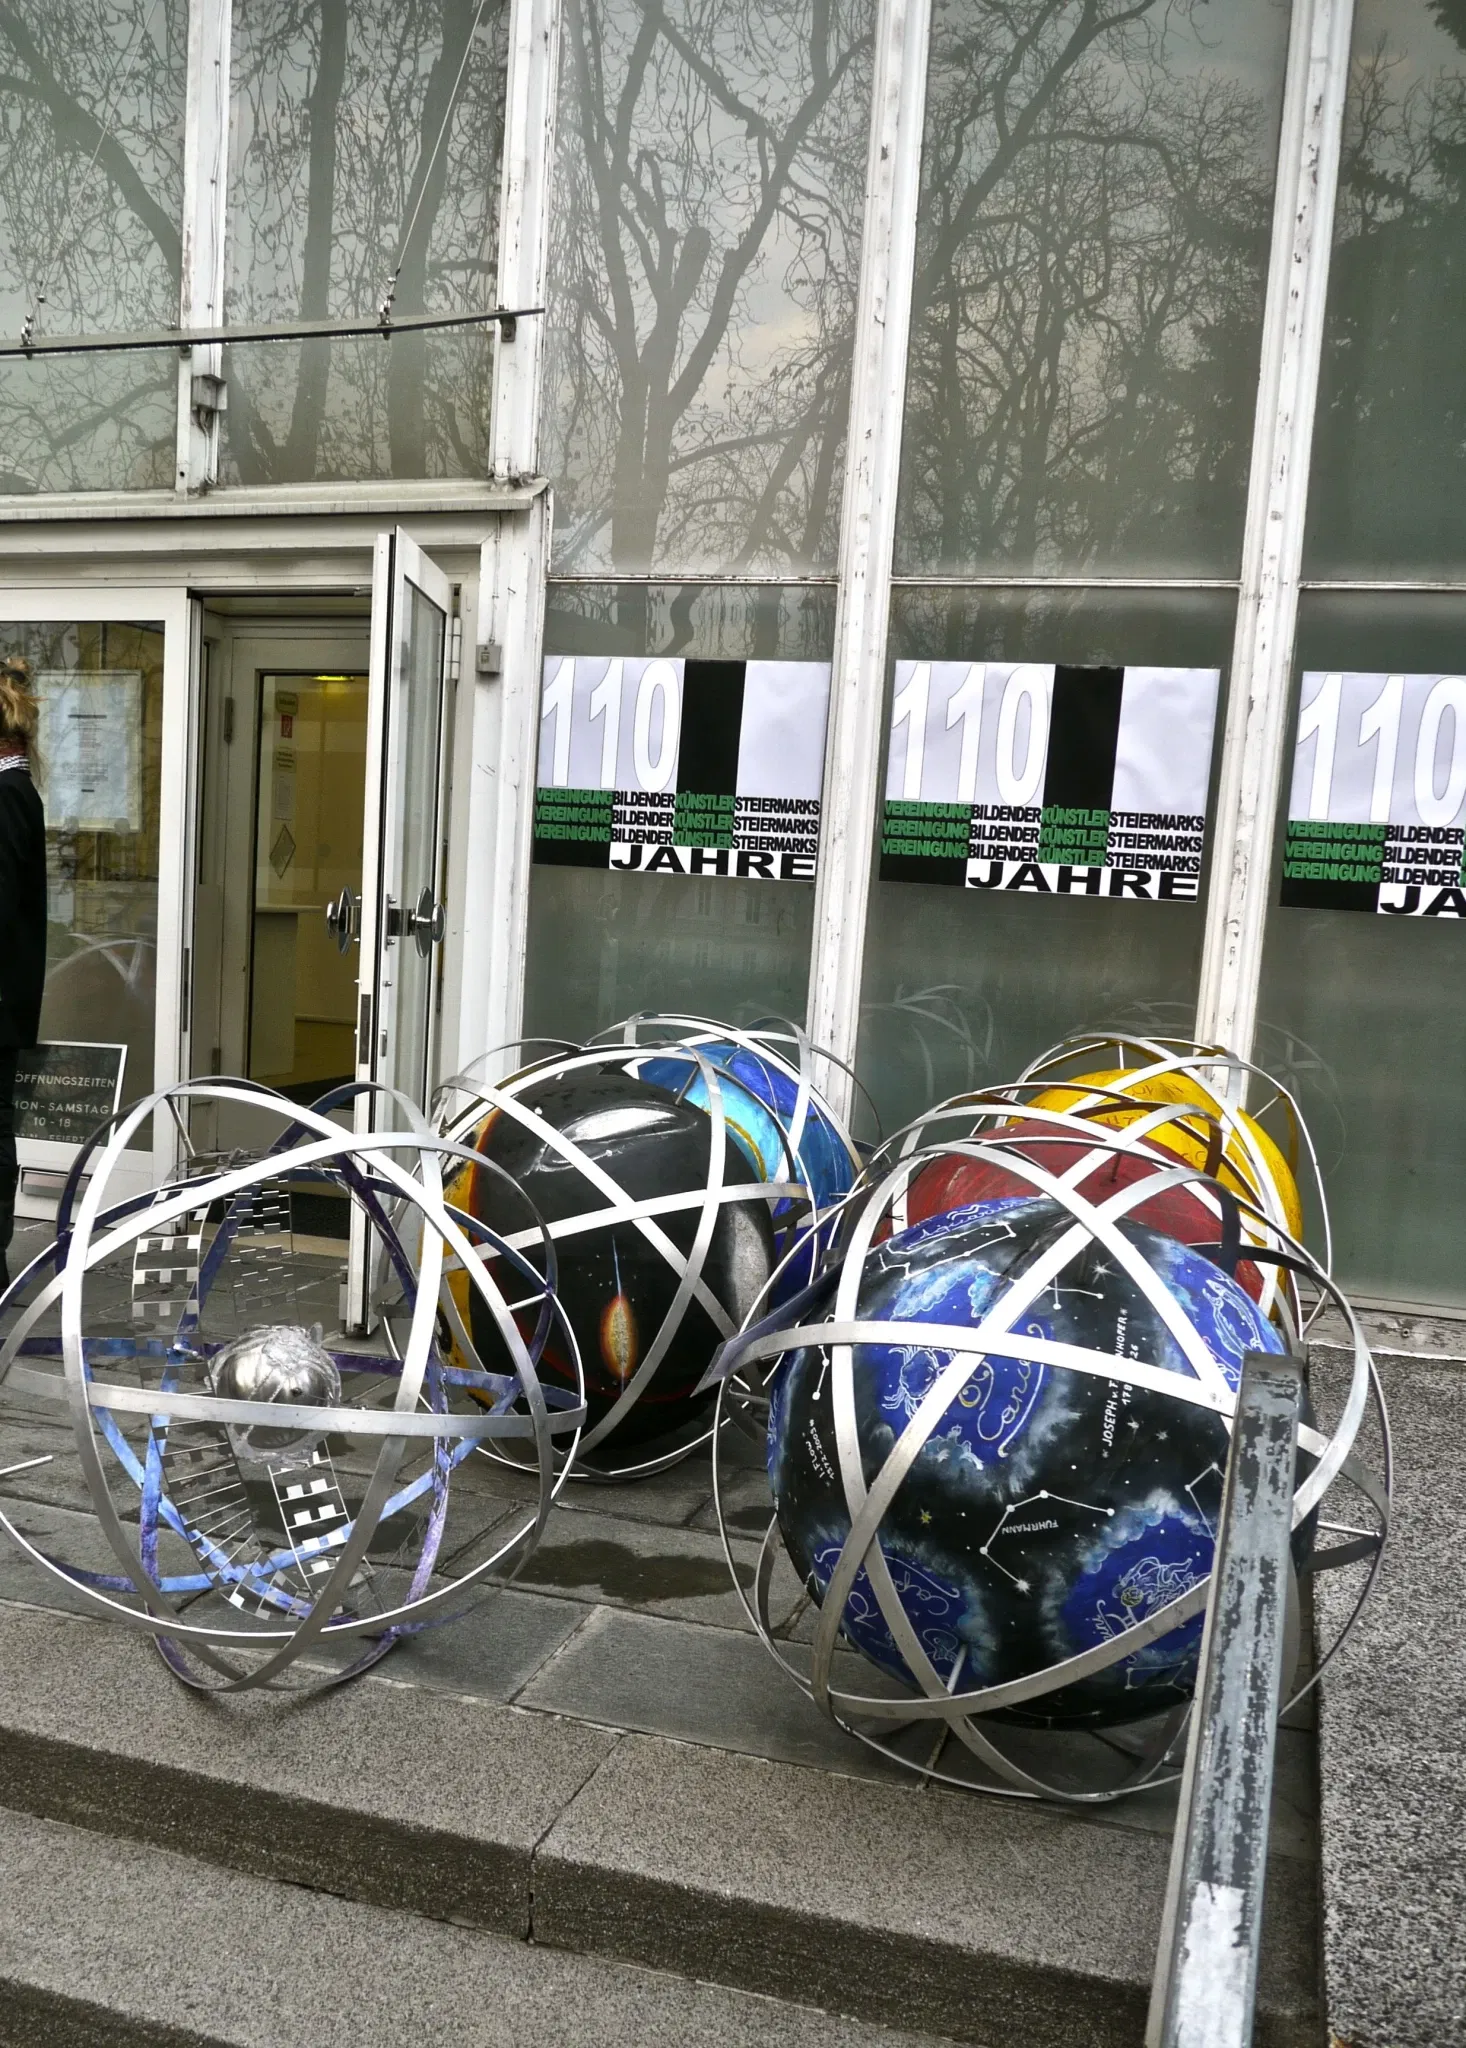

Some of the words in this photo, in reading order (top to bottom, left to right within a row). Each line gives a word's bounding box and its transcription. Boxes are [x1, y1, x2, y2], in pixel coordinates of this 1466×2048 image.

[541, 657, 681, 793] 110
[892, 662, 1049, 806] 110
[1297, 673, 1466, 828] 110
[613, 791, 675, 808] BILDENDER
[735, 796, 820, 815] STEIERMARKS
[612, 810, 674, 827] BILDENDER
[733, 816, 818, 835] STEIERMARKS
[971, 804, 1041, 824] BILDENDER
[1109, 812, 1205, 832] STEIERMARKS
[611, 828, 673, 845] BILDENDER
[732, 835, 817, 854] STEIERMARKS
[970, 824, 1040, 843] BILDENDER
[1107, 832, 1202, 853] STEIERMARKS
[1386, 825, 1464, 846] BILDENDER
[611, 845, 816, 881] JAHRE
[968, 843, 1038, 863] BILDENDER
[1105, 852, 1200, 873] STEIERMARKS
[1384, 846, 1462, 867] BILDENDER
[968, 861, 1198, 900] JAHRE
[1382, 866, 1460, 887] BILDENDER
[15, 1070, 115, 1088] ÖFFNUNGSZEITEN
[1102, 1399, 1118, 1447] JOSEPH
[1002, 1519, 1059, 1535] FUHRMANN
